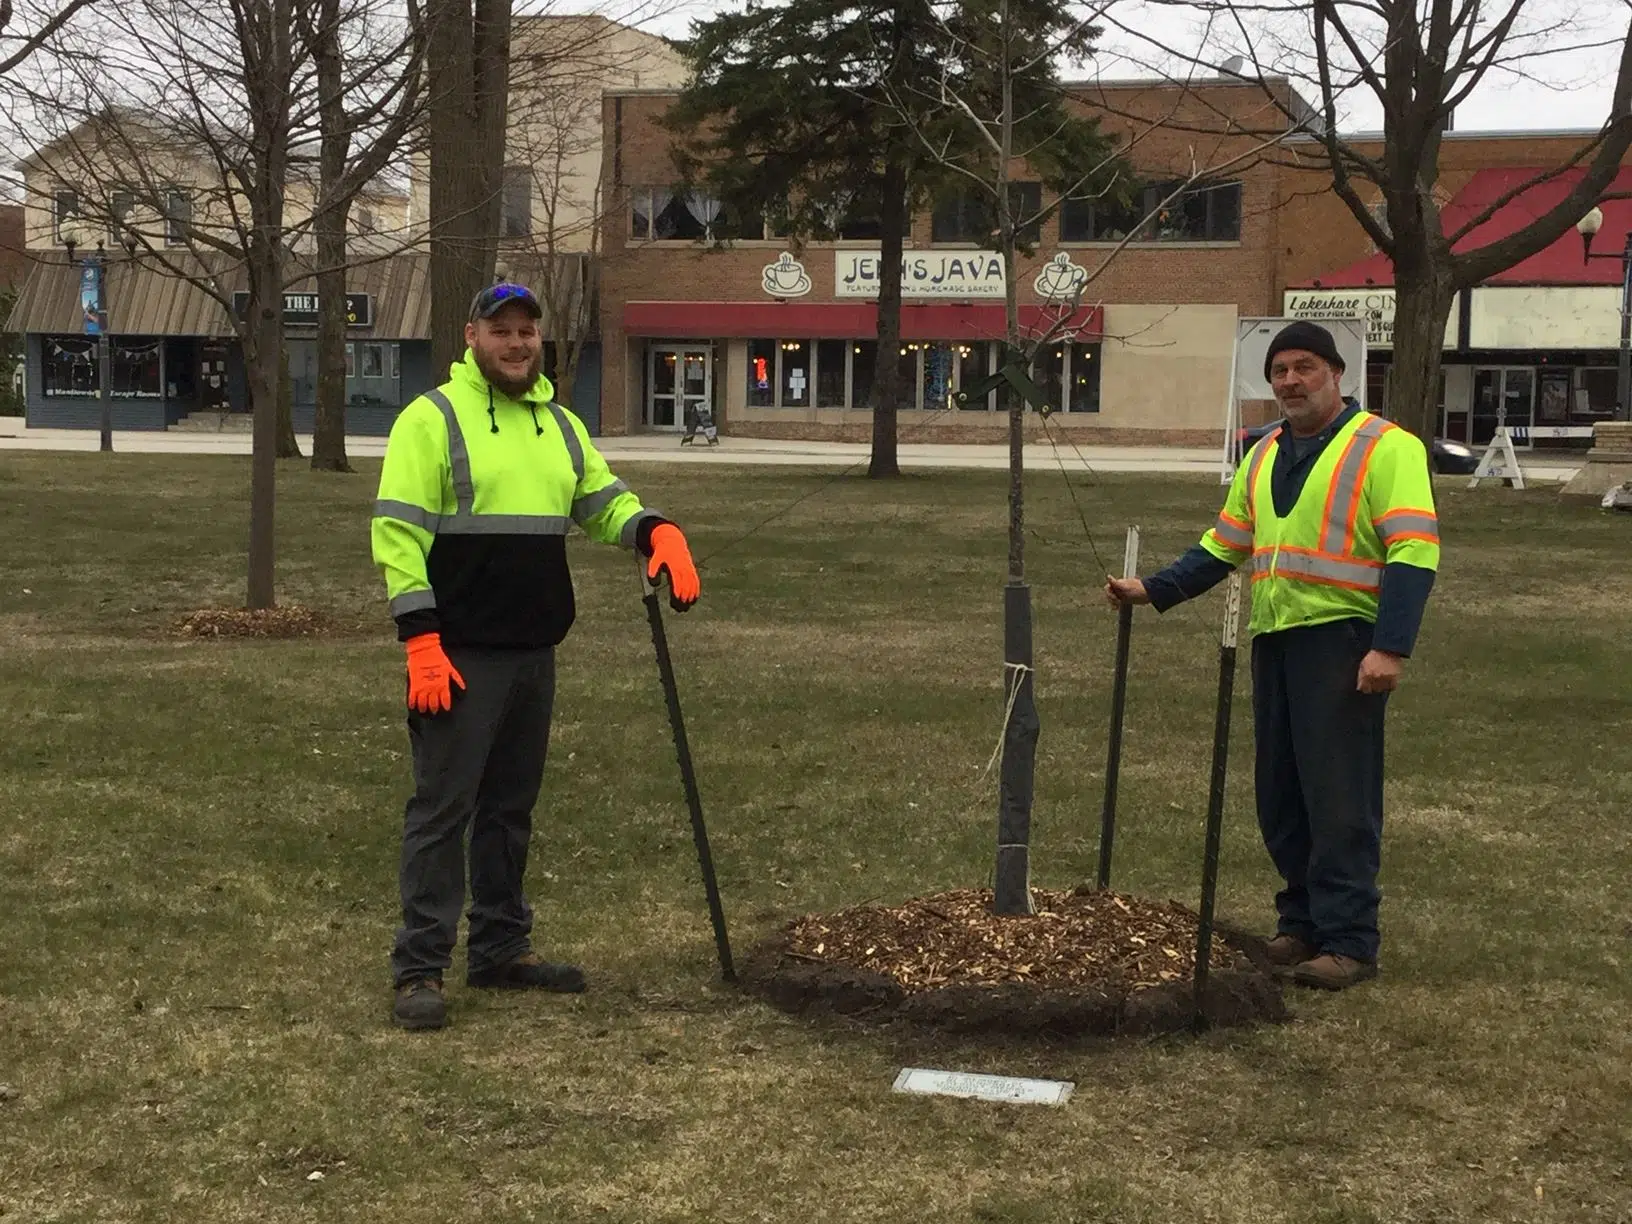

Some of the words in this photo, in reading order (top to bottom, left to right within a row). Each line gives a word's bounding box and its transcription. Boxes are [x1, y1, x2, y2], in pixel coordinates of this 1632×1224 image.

[931, 255, 1003, 283] JAVA
[285, 296, 311, 309] THE
[1289, 296, 1360, 310] Lakeshore
[1365, 295, 1396, 310] CIN
